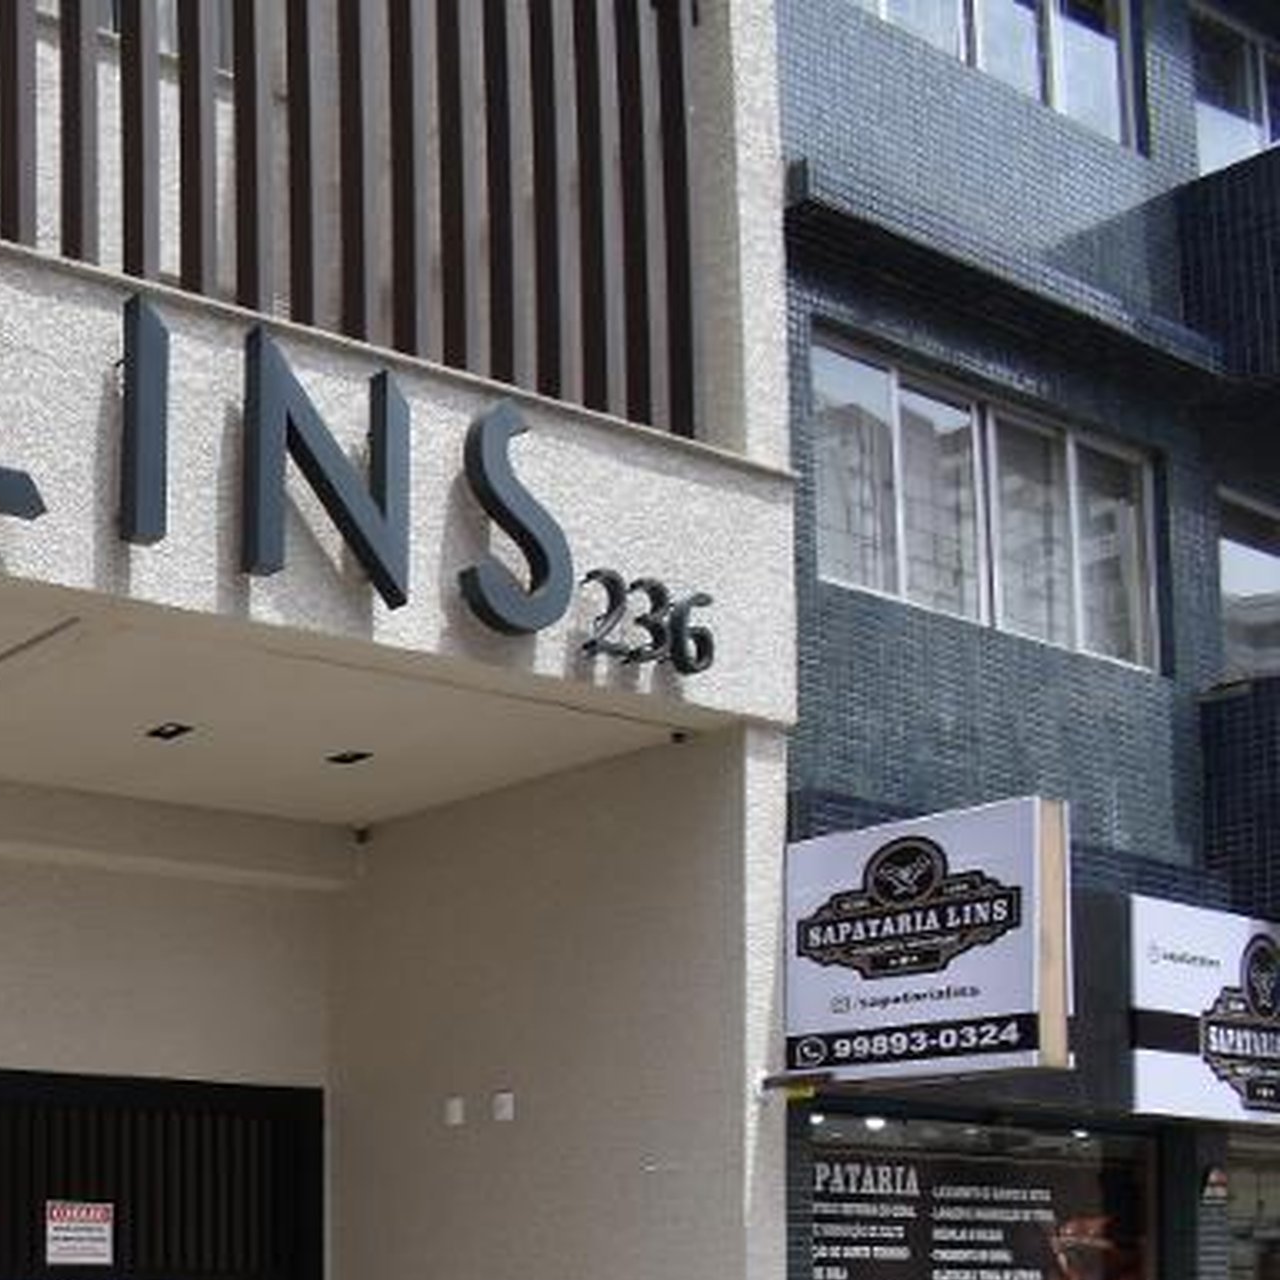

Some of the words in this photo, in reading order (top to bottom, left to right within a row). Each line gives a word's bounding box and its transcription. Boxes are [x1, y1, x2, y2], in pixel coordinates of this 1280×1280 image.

[580, 567, 715, 676] 236
[808, 907, 940, 948] SAPATARIA
[946, 898, 1008, 928] LINS
[833, 1021, 1020, 1058] 99893-0324
